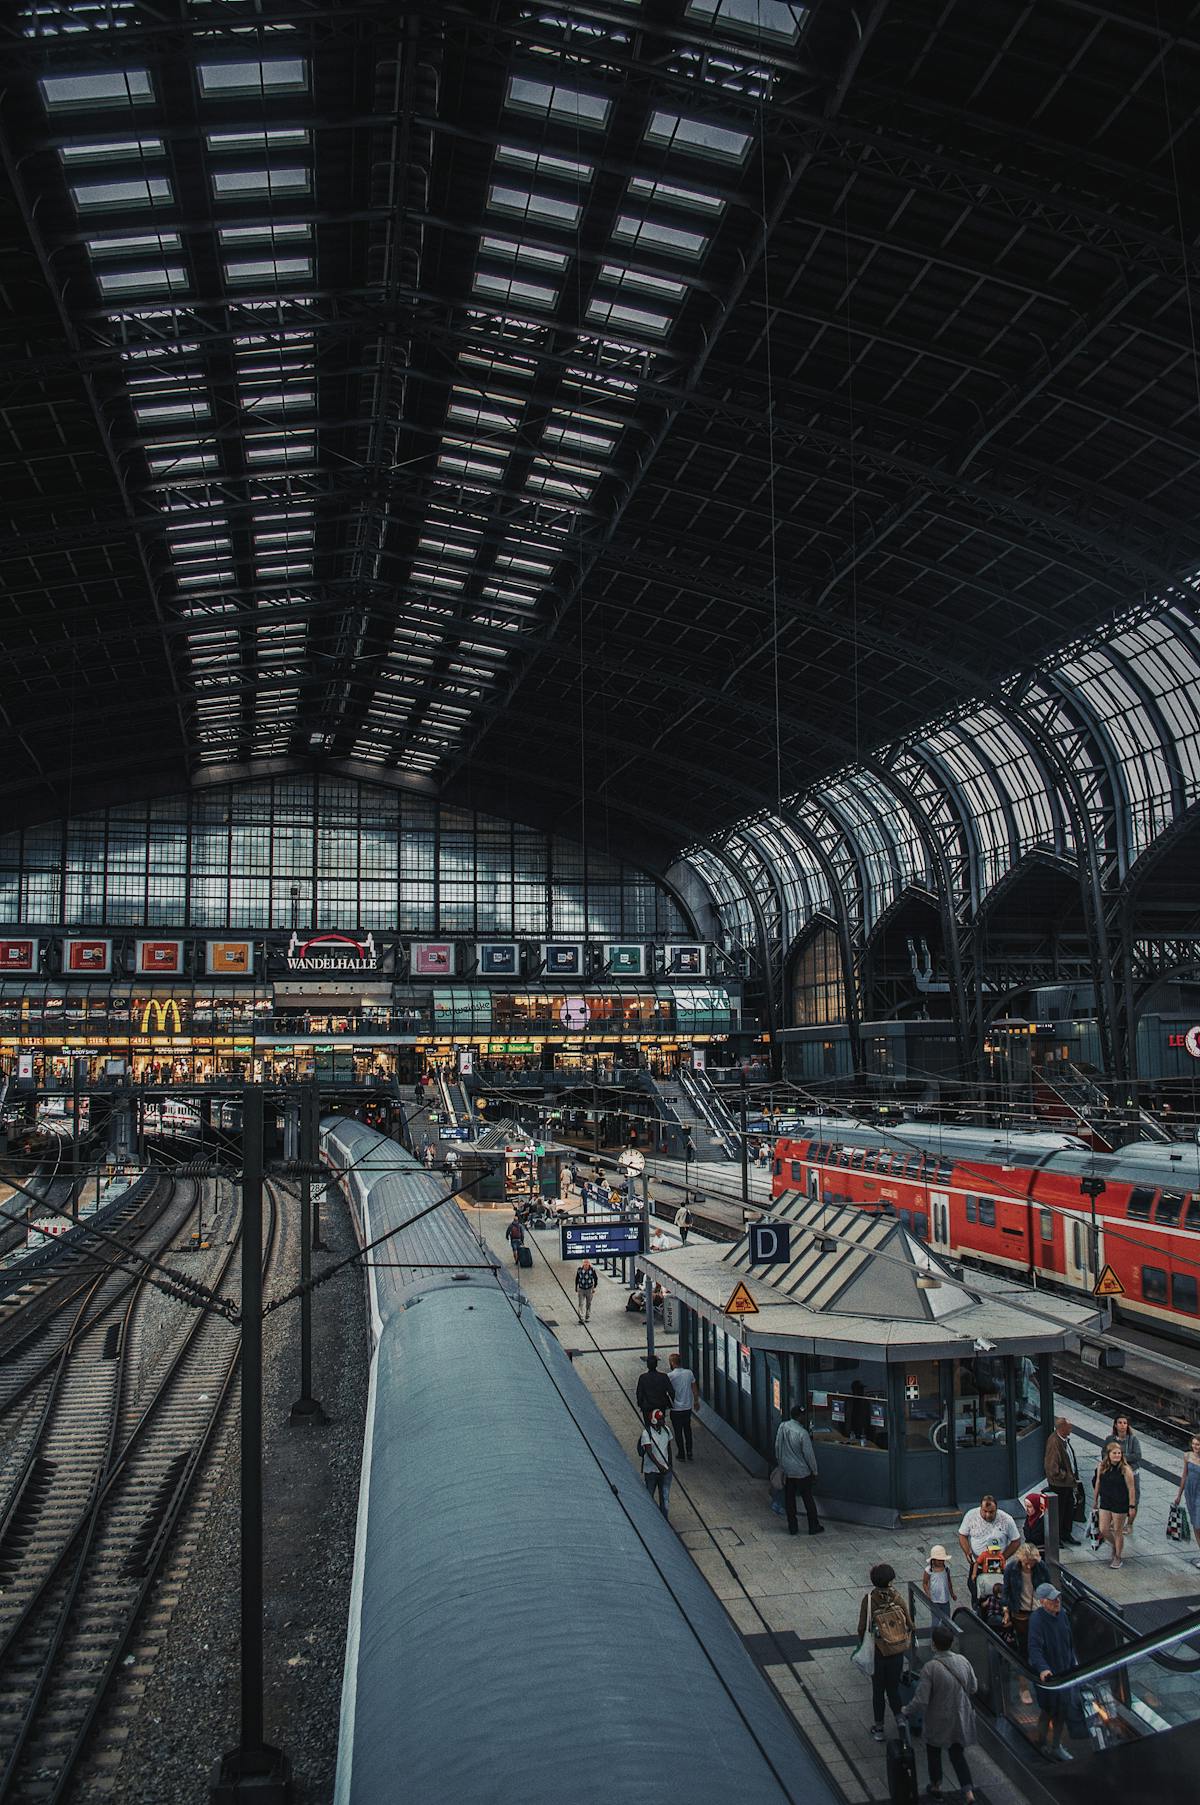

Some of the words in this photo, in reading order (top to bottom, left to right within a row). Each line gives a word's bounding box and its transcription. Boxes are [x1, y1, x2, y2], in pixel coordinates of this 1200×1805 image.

[287, 958, 377, 970] WANDELHALLE
[566, 1230, 573, 1240] 8
[756, 1228, 778, 1259] D
